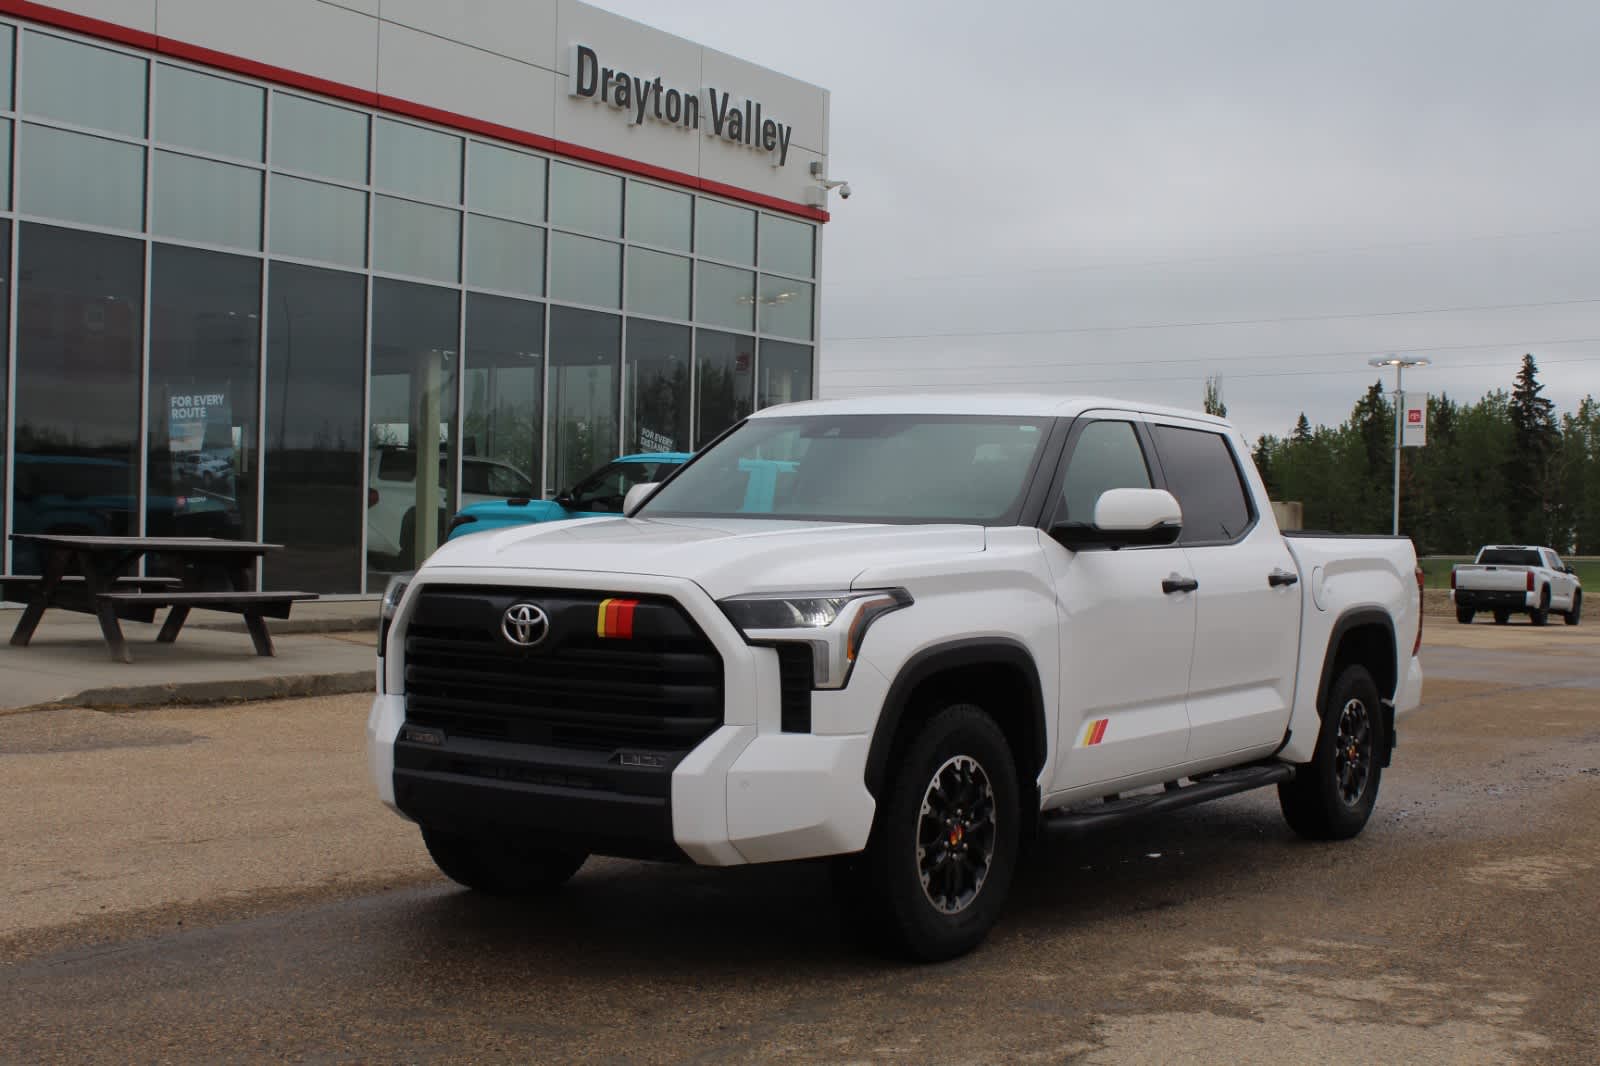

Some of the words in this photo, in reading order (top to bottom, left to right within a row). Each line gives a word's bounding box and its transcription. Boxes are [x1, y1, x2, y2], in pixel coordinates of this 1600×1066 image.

[575, 44, 699, 129] Drayton
[707, 87, 792, 167] Valley
[171, 396, 192, 407] FOR
[194, 394, 224, 406] EVERY
[171, 407, 207, 418] ROUTE
[655, 433, 673, 447] EVERY
